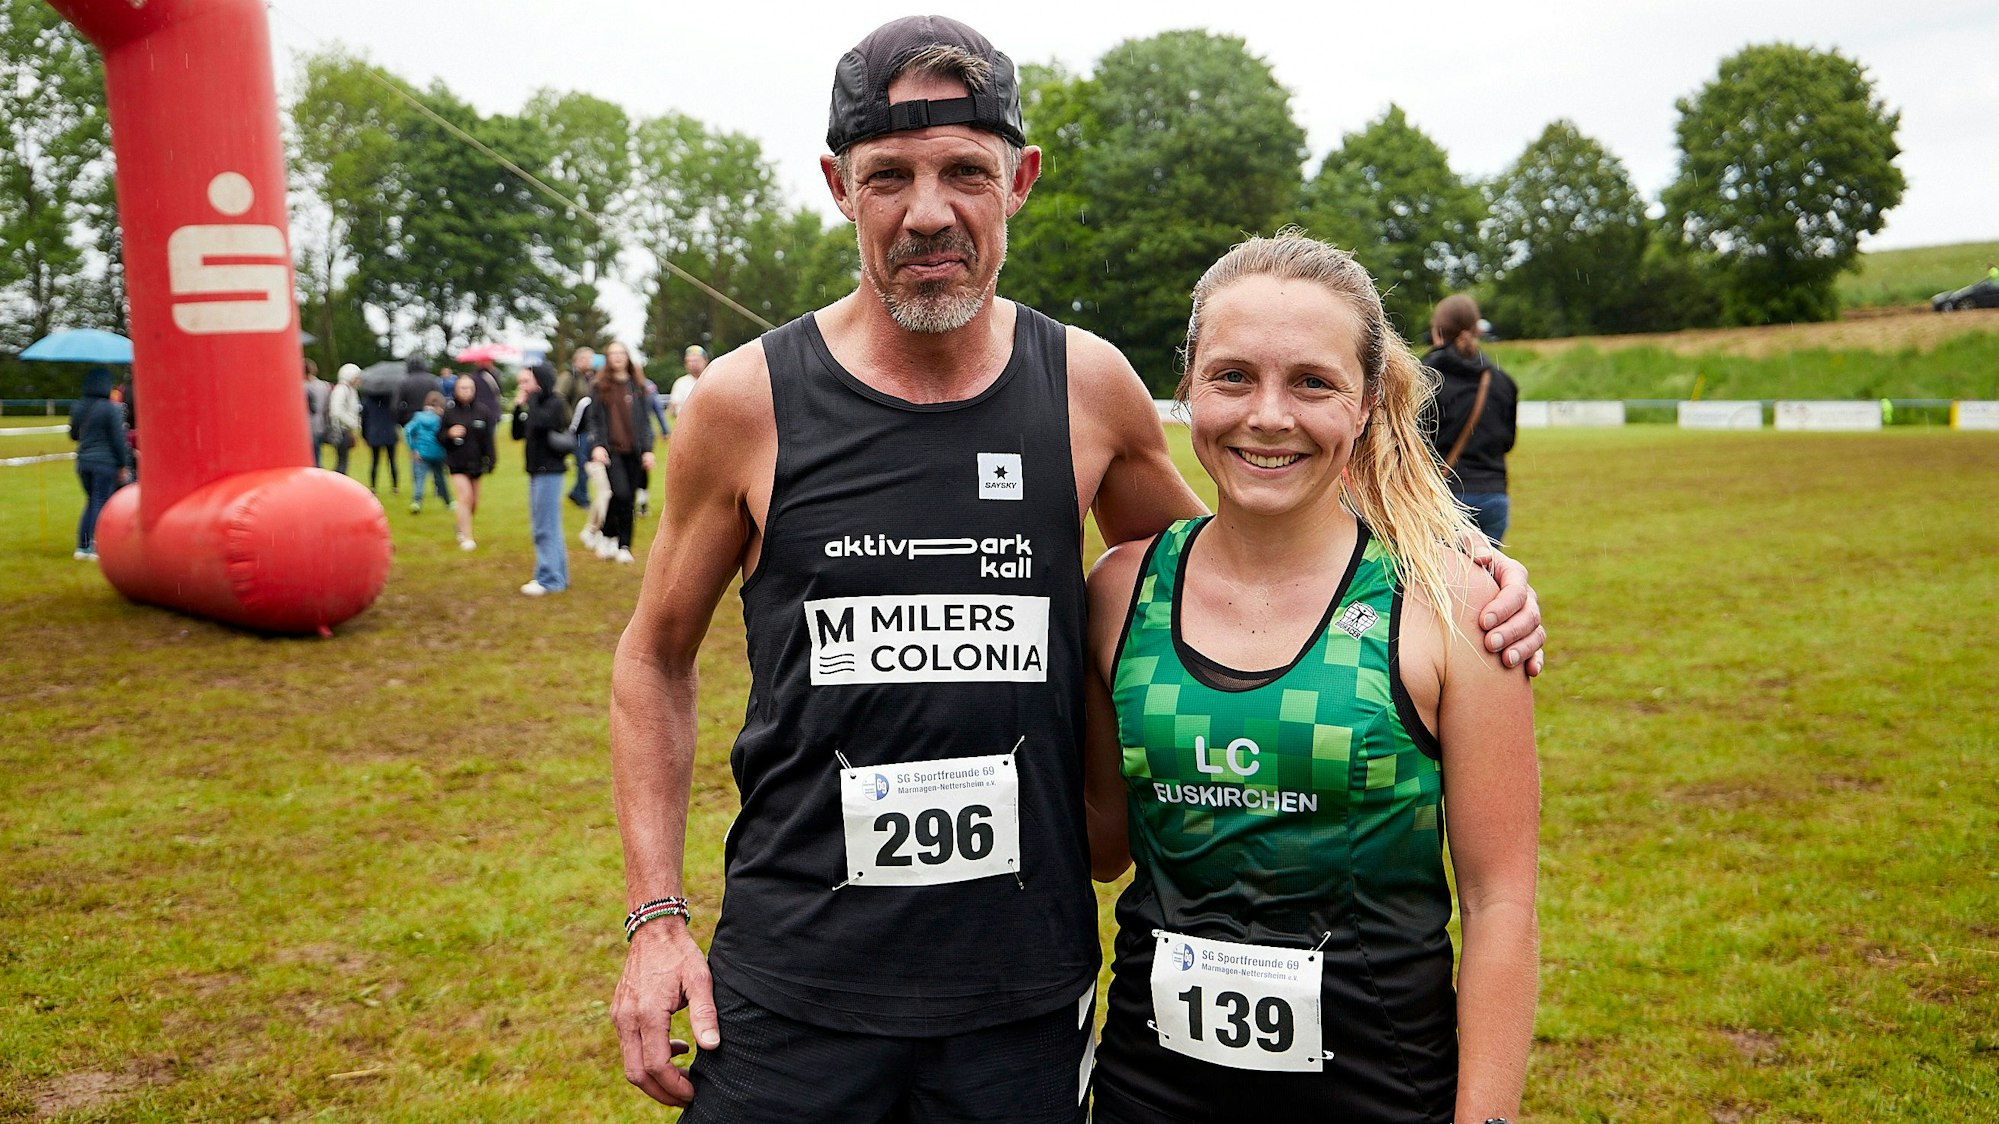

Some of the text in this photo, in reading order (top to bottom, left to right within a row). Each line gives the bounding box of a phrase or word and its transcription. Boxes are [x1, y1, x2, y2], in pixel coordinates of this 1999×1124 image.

[980, 556, 1032, 578] kall
[815, 607, 854, 650] M
[871, 604, 1015, 633] MILERS
[870, 643, 1042, 672] COLONIA
[1195, 736, 1260, 776] LC
[897, 766, 995, 784] SG Sportfreunde 69
[898, 781, 984, 794] Marmagen-Nettersheim
[1153, 782, 1318, 813] EUSKIRCHEN
[873, 804, 995, 867] 296
[1201, 963, 1286, 980] Marmagen-Nettersheim
[1202, 950, 1215, 961] SG
[1217, 952, 1284, 969] Sportfreunde
[1286, 959, 1300, 970] 69
[1178, 985, 1295, 1053] 139
